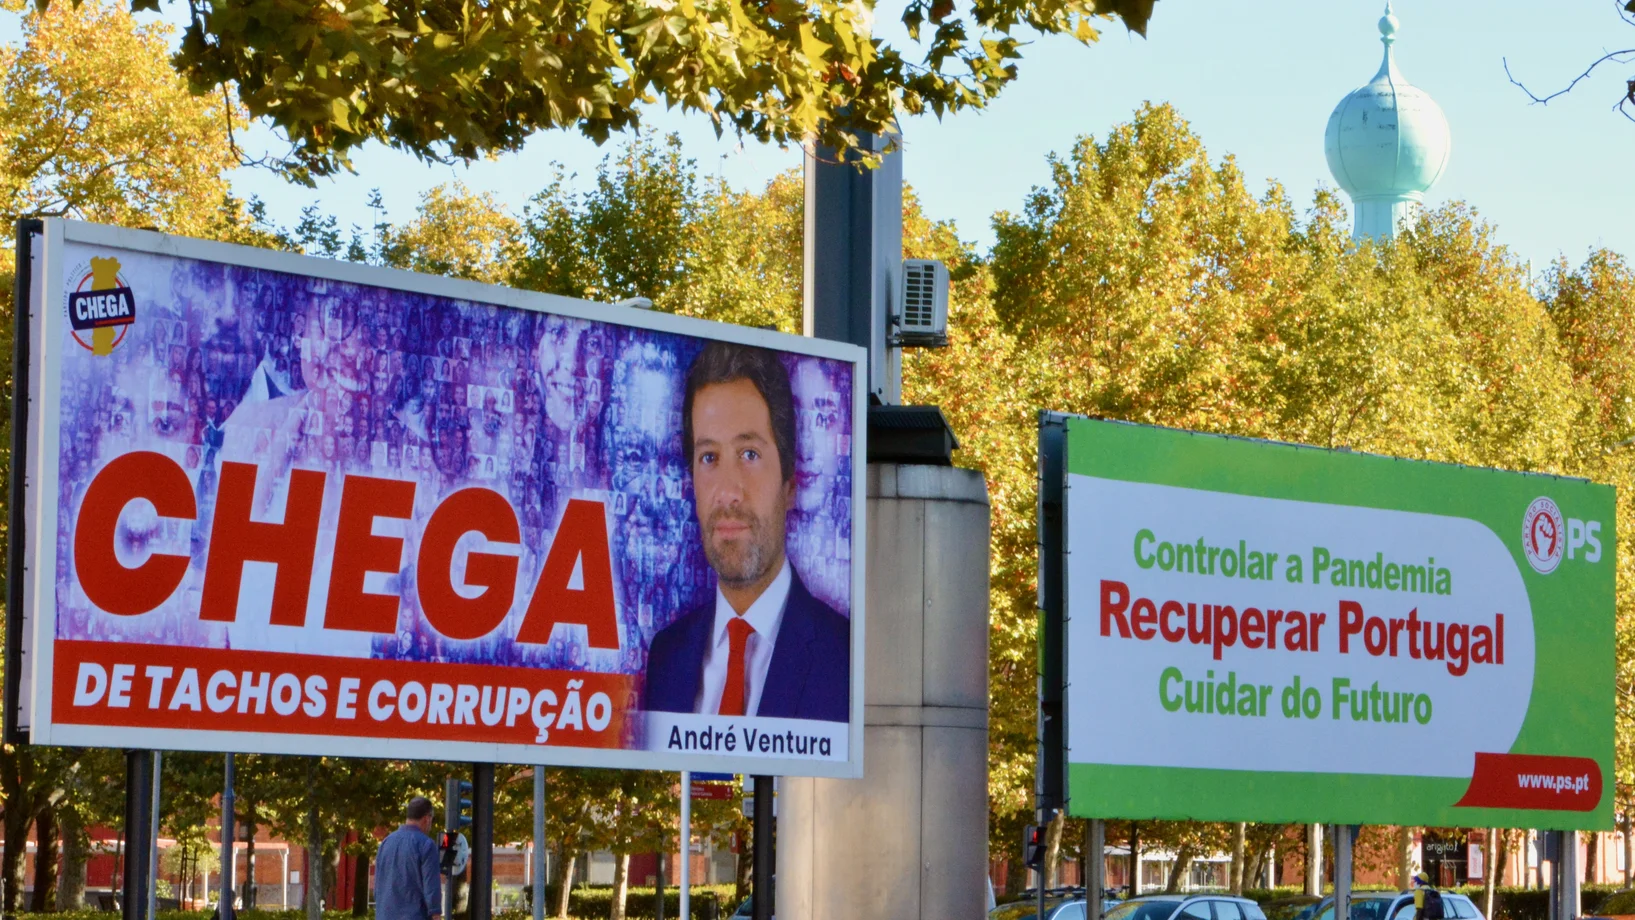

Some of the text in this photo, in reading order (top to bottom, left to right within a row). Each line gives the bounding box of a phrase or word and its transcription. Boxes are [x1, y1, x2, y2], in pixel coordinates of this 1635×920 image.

[75, 293, 130, 321] CHEGA
[73, 450, 620, 650] CHEGA
[1523, 501, 1563, 558] PARTIDO SOCIALISTA
[1566, 517, 1603, 564] PS
[1133, 528, 1452, 596] Controlar a Pandemia
[1100, 579, 1504, 677] Recuperar Portugal
[73, 662, 612, 744] DE TACHOS E CORRUPÇÃO
[1158, 666, 1433, 725] Cuidar do Futuro
[667, 724, 831, 757] André Ventura
[1517, 773, 1589, 795] www.ps.pt
